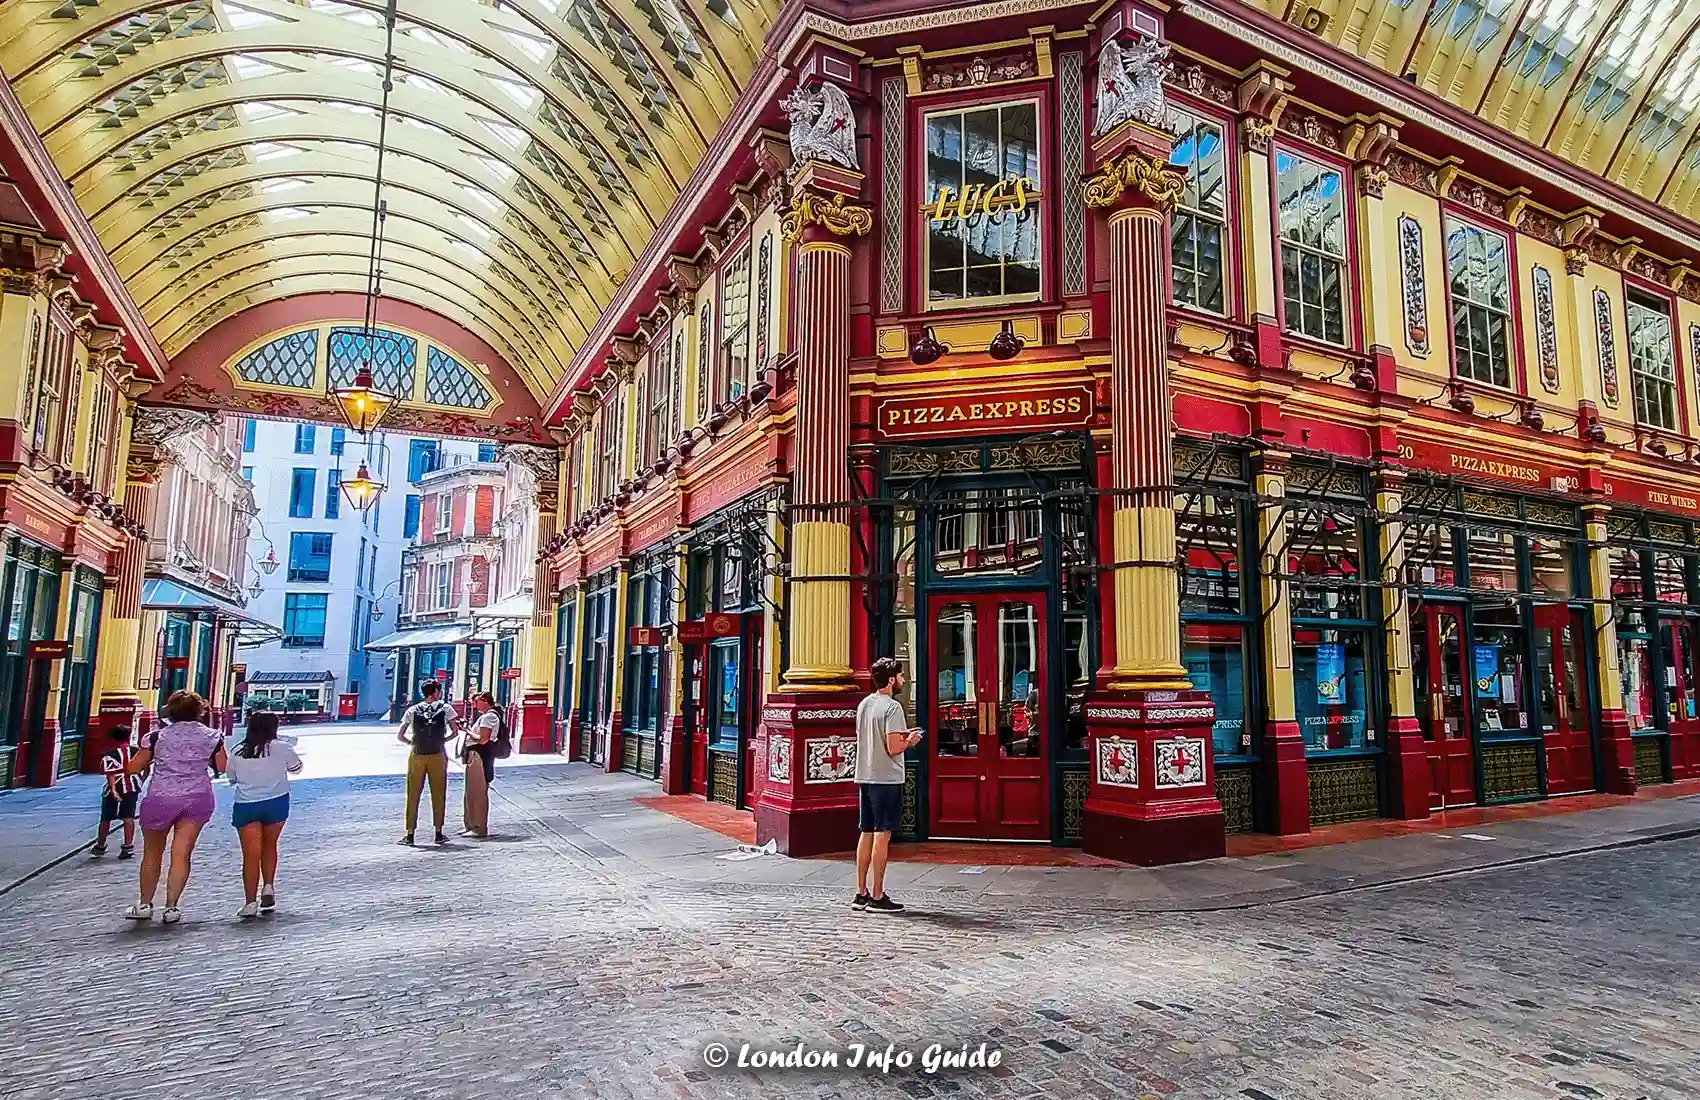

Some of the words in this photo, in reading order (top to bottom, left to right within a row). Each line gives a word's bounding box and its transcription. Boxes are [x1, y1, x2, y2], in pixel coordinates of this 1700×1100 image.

[932, 173, 1032, 221] LUC'S
[888, 396, 1082, 426] PIZZAEXPRESS
[1398, 444, 1414, 460] 20
[1450, 453, 1540, 482] PIZZAEXPRESS
[1603, 482, 1613, 496] 19
[1647, 490, 1669, 505] FINE
[1669, 494, 1698, 509] WINES
[1304, 715, 1360, 726] PIZZAEXPRESS
